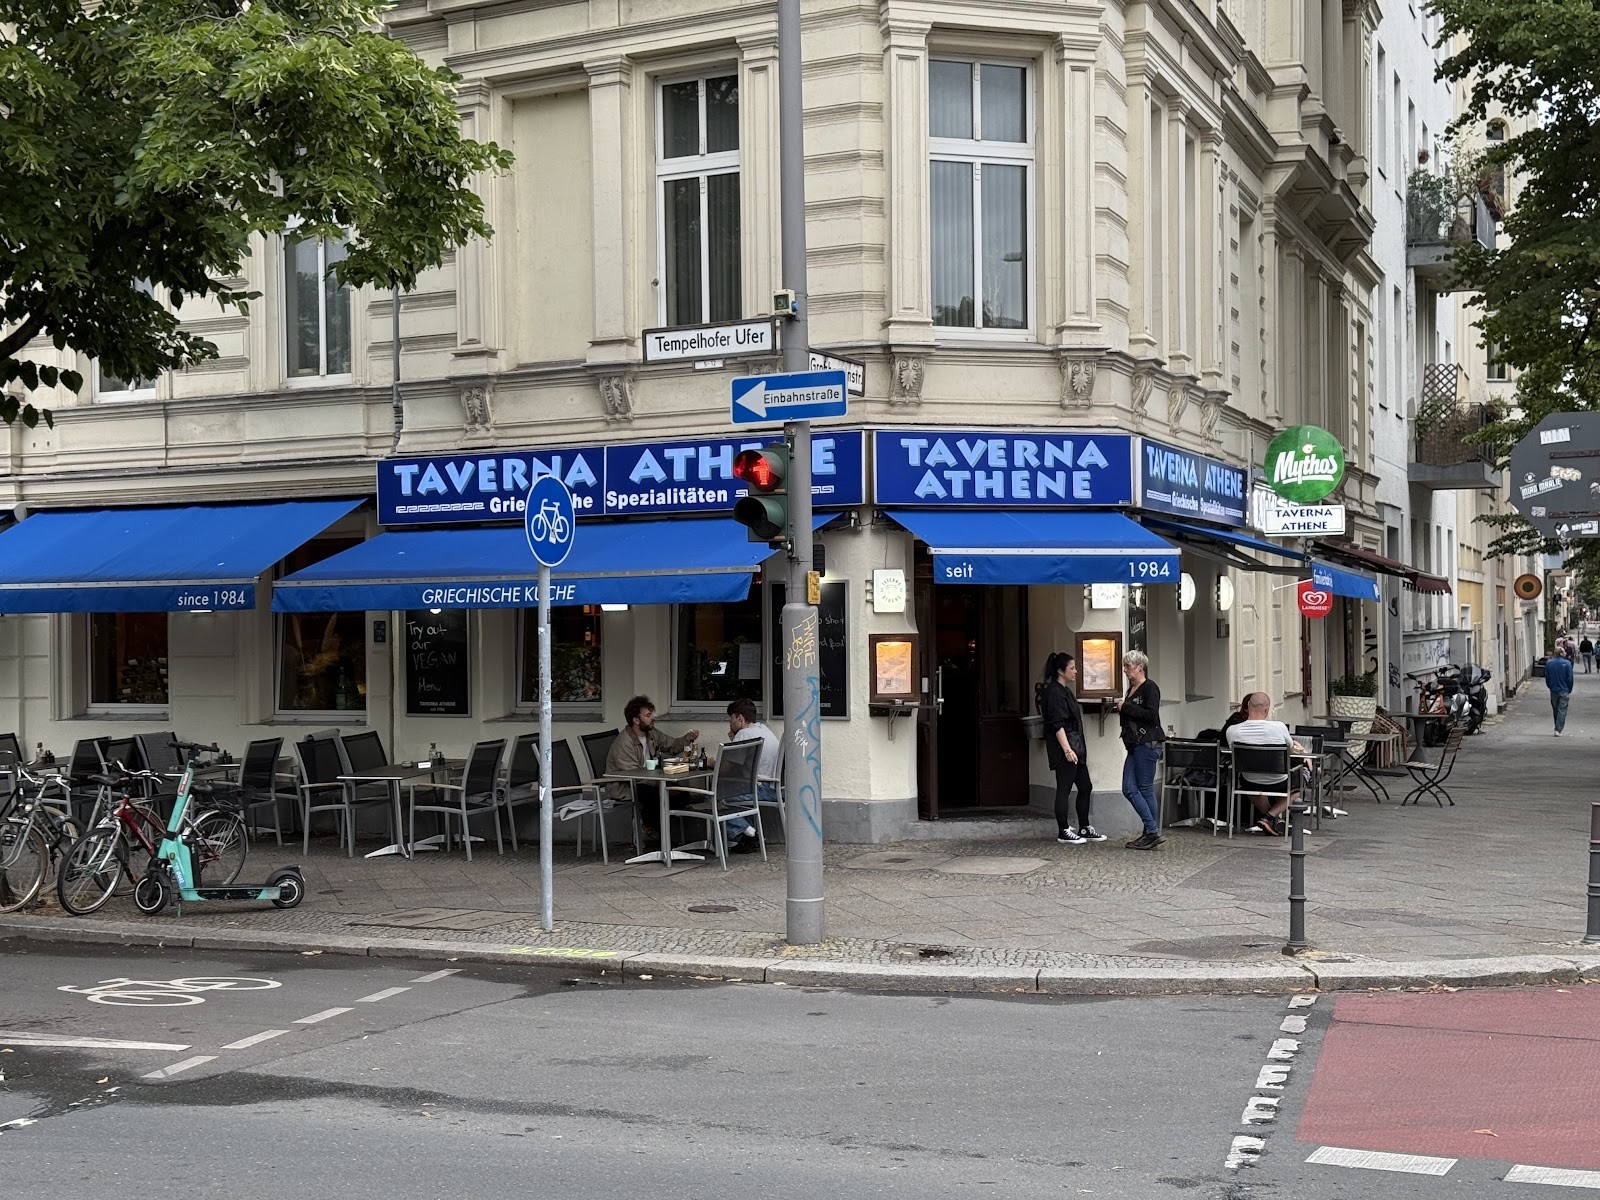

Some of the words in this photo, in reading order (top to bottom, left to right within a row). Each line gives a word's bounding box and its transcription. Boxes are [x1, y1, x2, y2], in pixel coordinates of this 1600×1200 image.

[655, 331, 731, 354] Tempelhofer
[735, 328, 765, 345] Ufer
[763, 388, 840, 404] Einbahnstraße
[629, 438, 836, 485] ATHE
[900, 437, 1110, 469] TAVERNA
[394, 452, 598, 496] TAVERNA
[1146, 445, 1199, 489] TAVERNA
[1204, 463, 1243, 500] ATHENE
[1273, 450, 1338, 485] Mythos
[913, 468, 1093, 499] ATHENE
[489, 493, 594, 513] Griehe
[606, 487, 728, 510] Spezialitäten
[1274, 508, 1333, 518] TAVERNA
[1281, 521, 1328, 531] ATHENE
[945, 563, 974, 578] seit
[1128, 561, 1171, 578] 1984
[177, 591, 209, 606] since
[213, 590, 245, 606] 1984
[422, 587, 521, 604] GRIECHISCHE
[406, 621, 424, 640] Try
[426, 624, 448, 636] out
[411, 641, 431, 651] our
[413, 651, 457, 671] VEGAN
